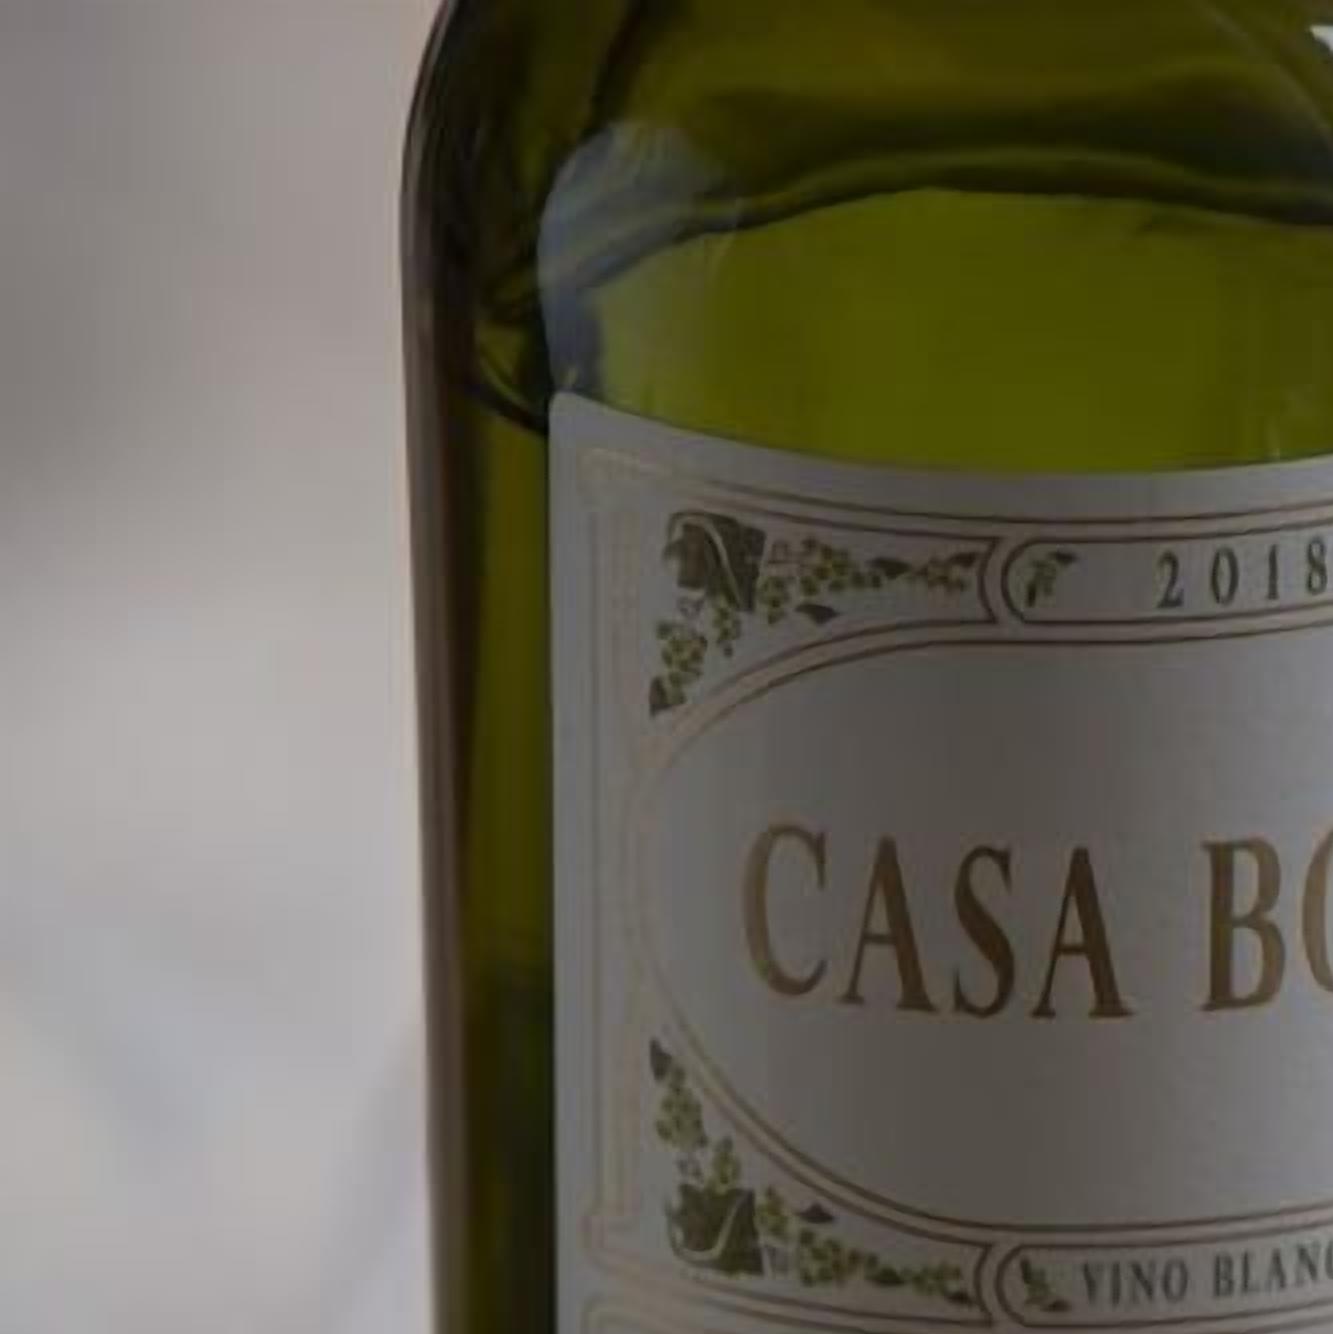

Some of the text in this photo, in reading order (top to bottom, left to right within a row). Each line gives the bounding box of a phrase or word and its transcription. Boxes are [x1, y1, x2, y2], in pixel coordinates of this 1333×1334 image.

[1155, 538, 1333, 609] 2018
[740, 822, 1134, 1019] CASA
[1080, 1257, 1189, 1307] VINO
